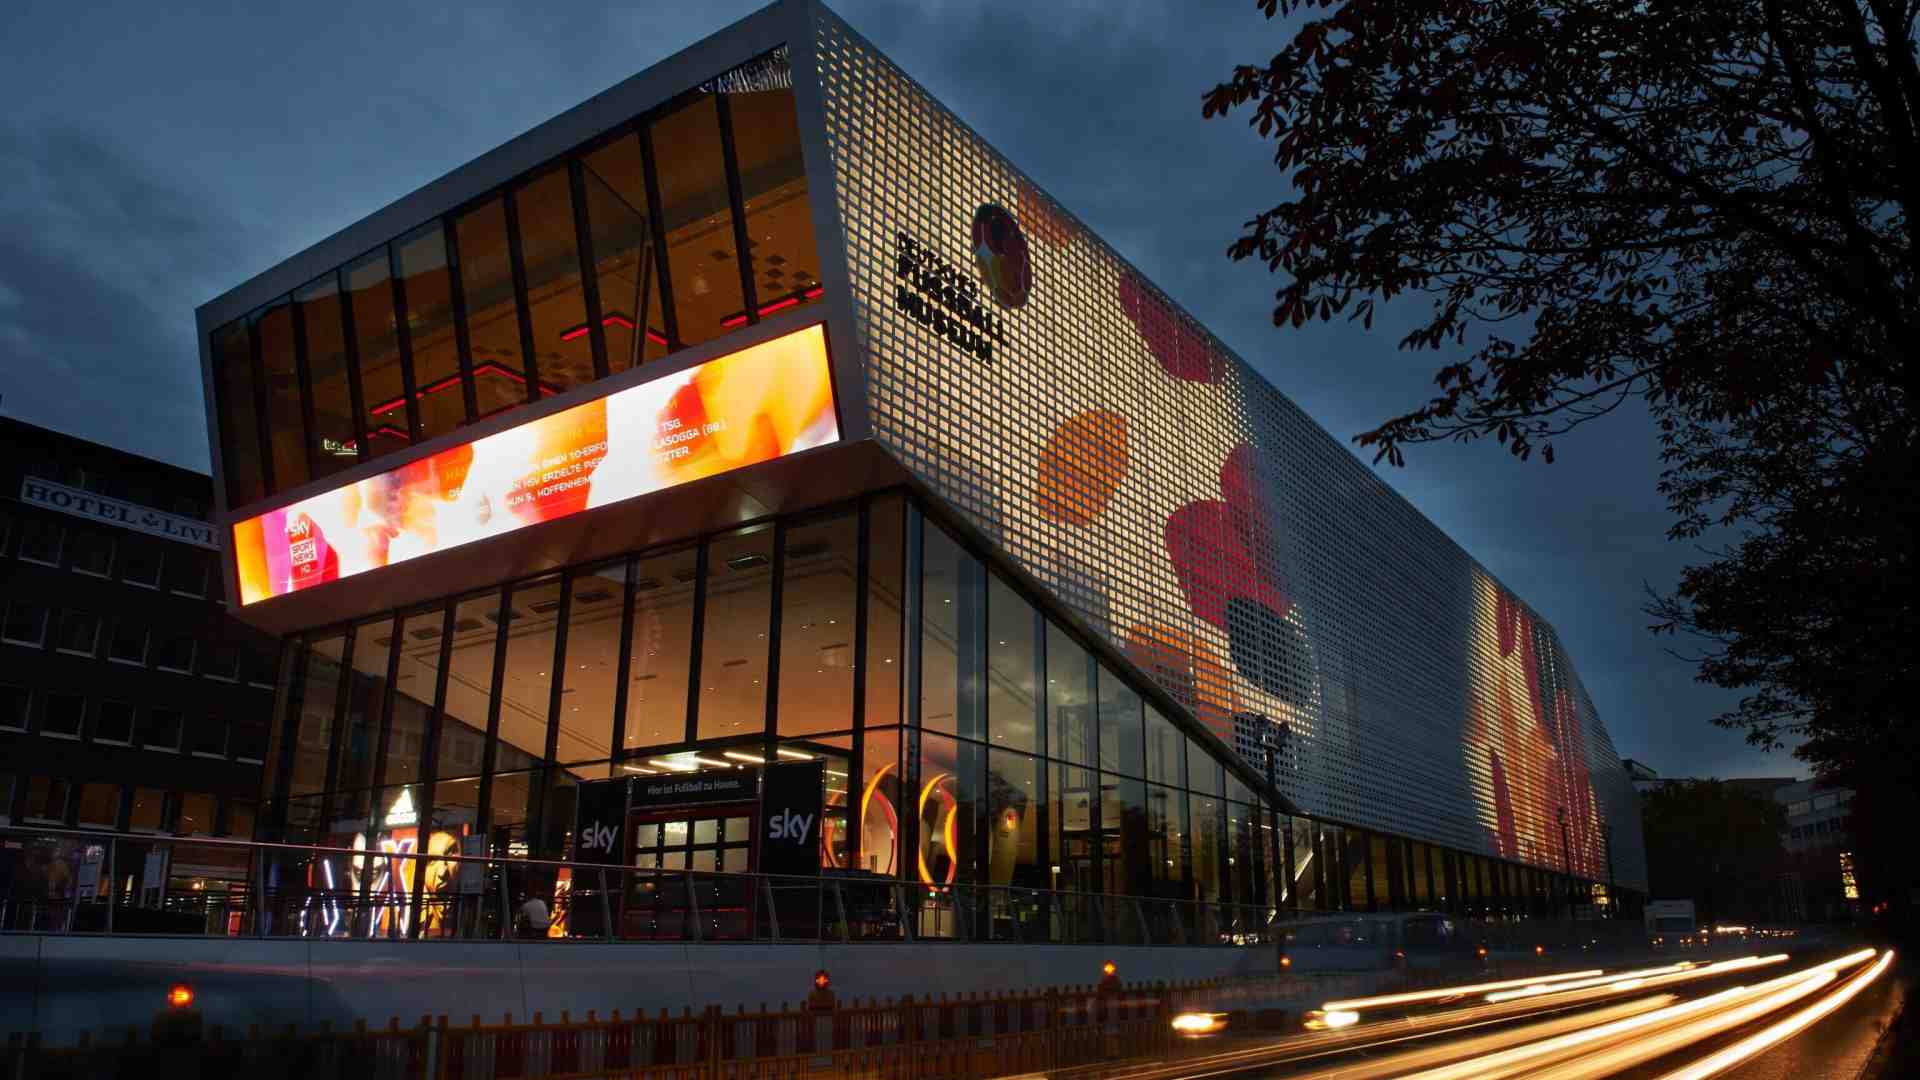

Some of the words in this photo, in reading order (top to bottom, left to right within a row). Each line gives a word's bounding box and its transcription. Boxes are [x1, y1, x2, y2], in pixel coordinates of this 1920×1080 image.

[29, 483, 137, 525] HOTEL
[140, 513, 160, 528] &
[581, 819, 619, 854] sky
[769, 807, 814, 845] sky
